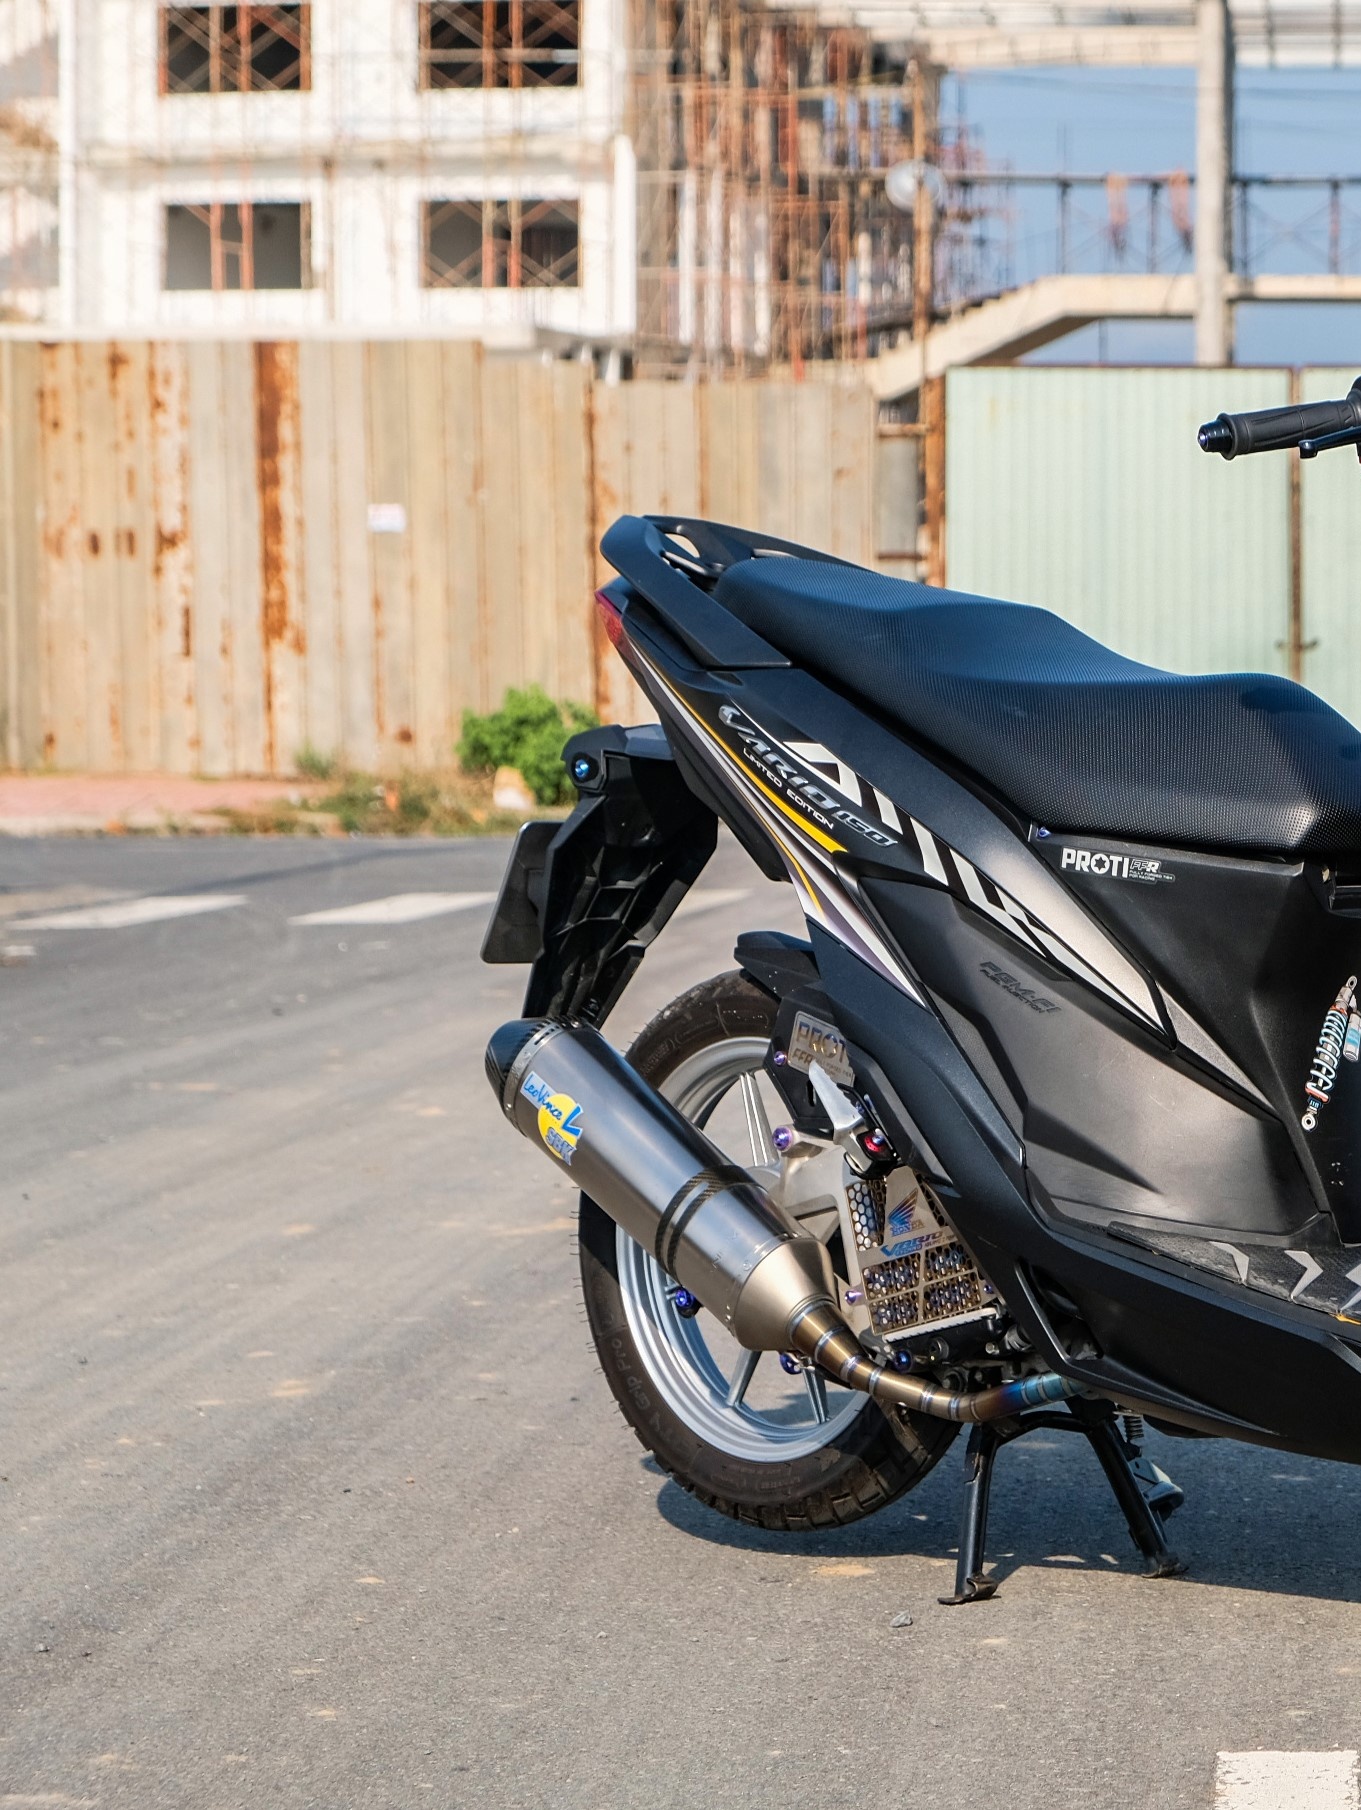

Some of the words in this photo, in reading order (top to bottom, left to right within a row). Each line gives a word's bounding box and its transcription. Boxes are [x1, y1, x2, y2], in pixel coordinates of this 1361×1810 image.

[718, 704, 841, 810] VARIO
[832, 809, 898, 847] 150
[743, 747, 783, 788] LIMITED
[786, 787, 834, 830] EDITION
[1061, 847, 1129, 879] PROTI
